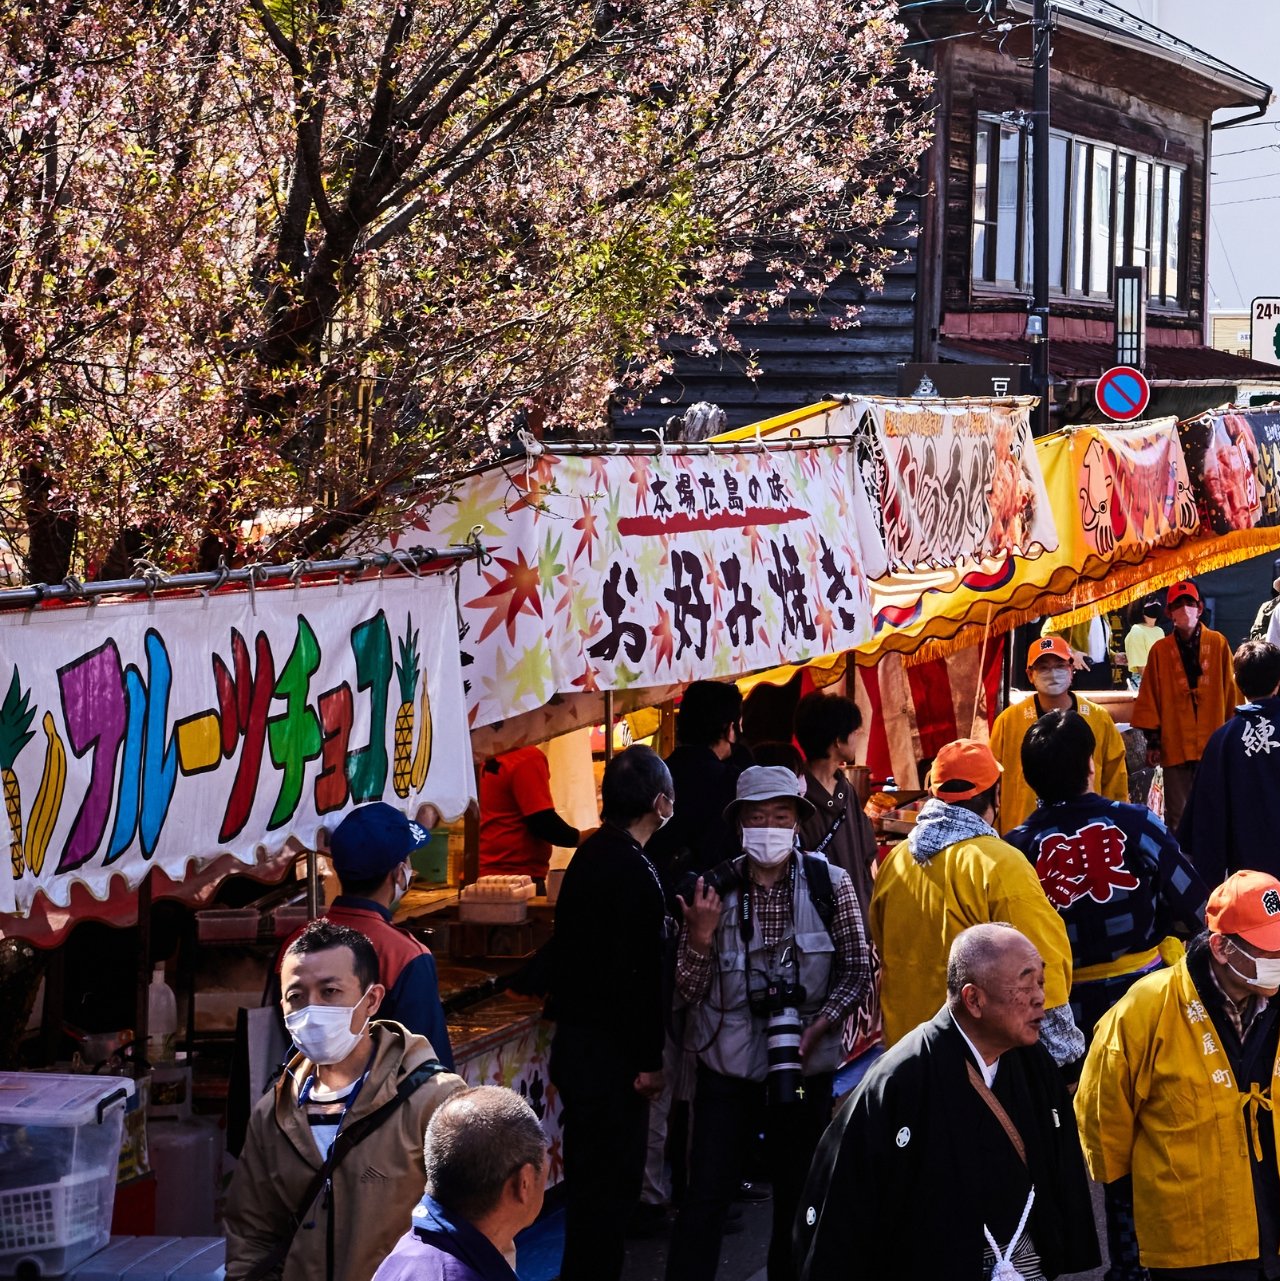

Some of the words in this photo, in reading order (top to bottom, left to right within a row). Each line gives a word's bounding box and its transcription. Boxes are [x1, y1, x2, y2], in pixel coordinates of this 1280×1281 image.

[1256, 303, 1280, 320] 24h
[650, 468, 791, 518] 本場広島の味
[586, 533, 857, 664] お好み焼き
[55, 608, 394, 876] フルーツチョコ
[1187, 999, 1233, 1090] 練屋町
